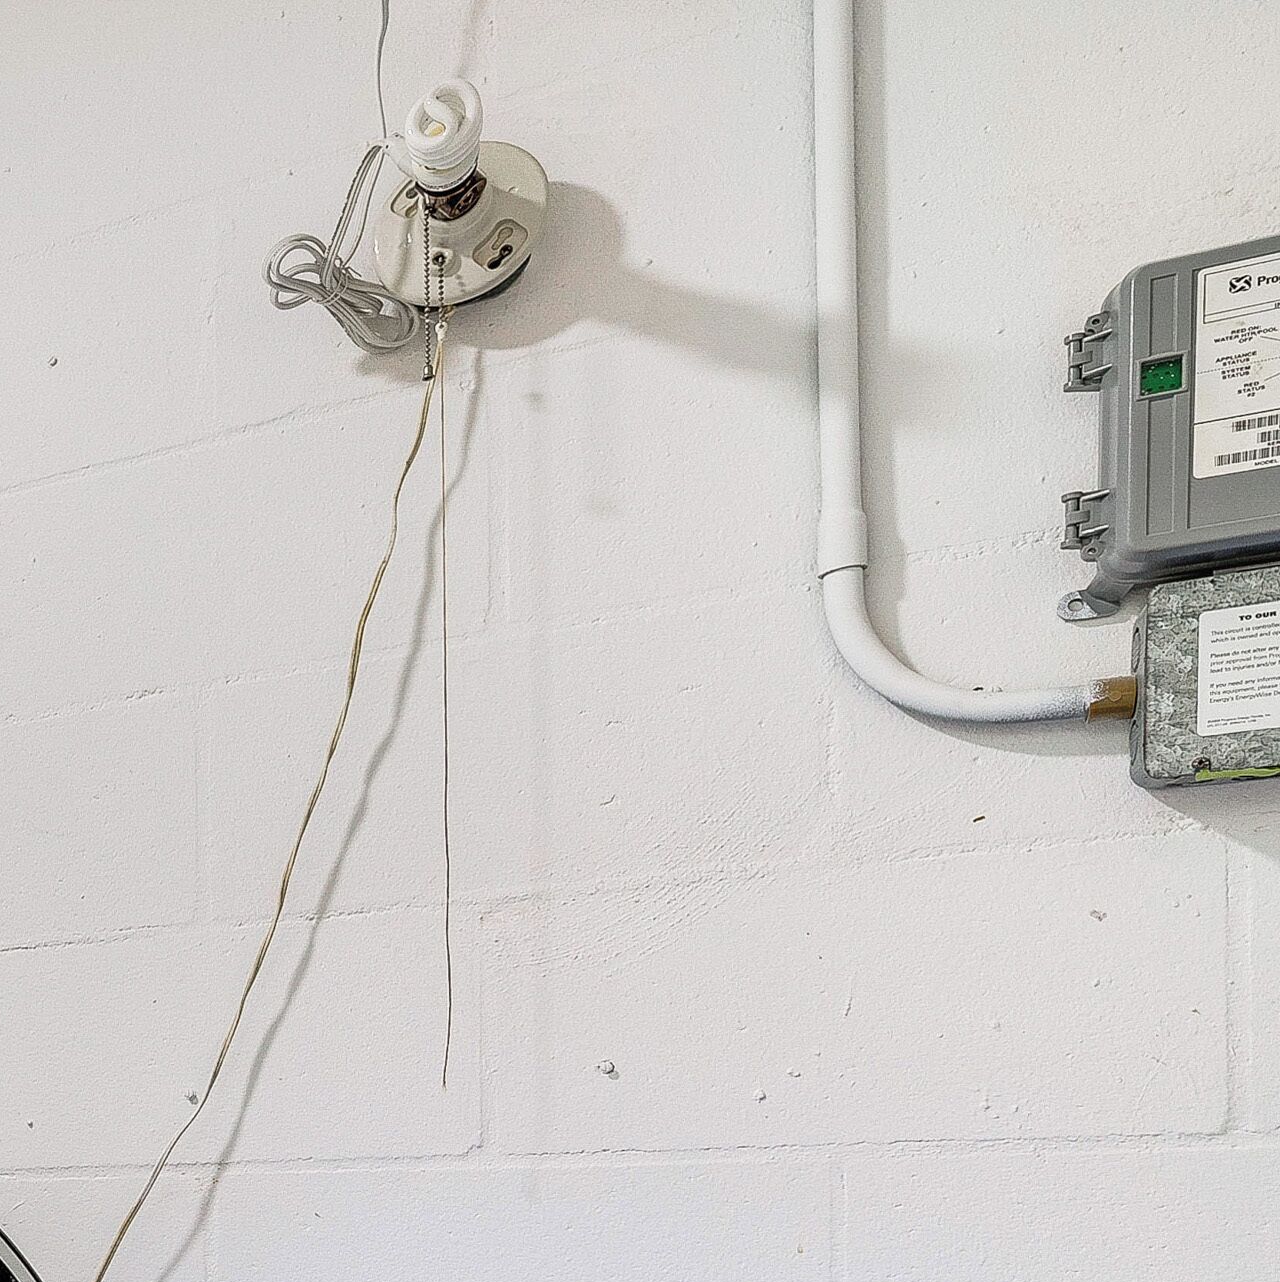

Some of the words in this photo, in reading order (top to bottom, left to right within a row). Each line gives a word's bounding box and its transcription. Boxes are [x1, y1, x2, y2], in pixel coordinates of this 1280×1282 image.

[1258, 276, 1280, 286] Pro
[1214, 334, 1239, 343] WATER
[1216, 351, 1258, 363] APPLIANCE
[1222, 358, 1250, 366] STATUS
[1221, 366, 1251, 374] SYSTEM
[1222, 371, 1250, 380] STATUS
[1238, 385, 1266, 394] STATUS
[1226, 656, 1251, 664] approval
